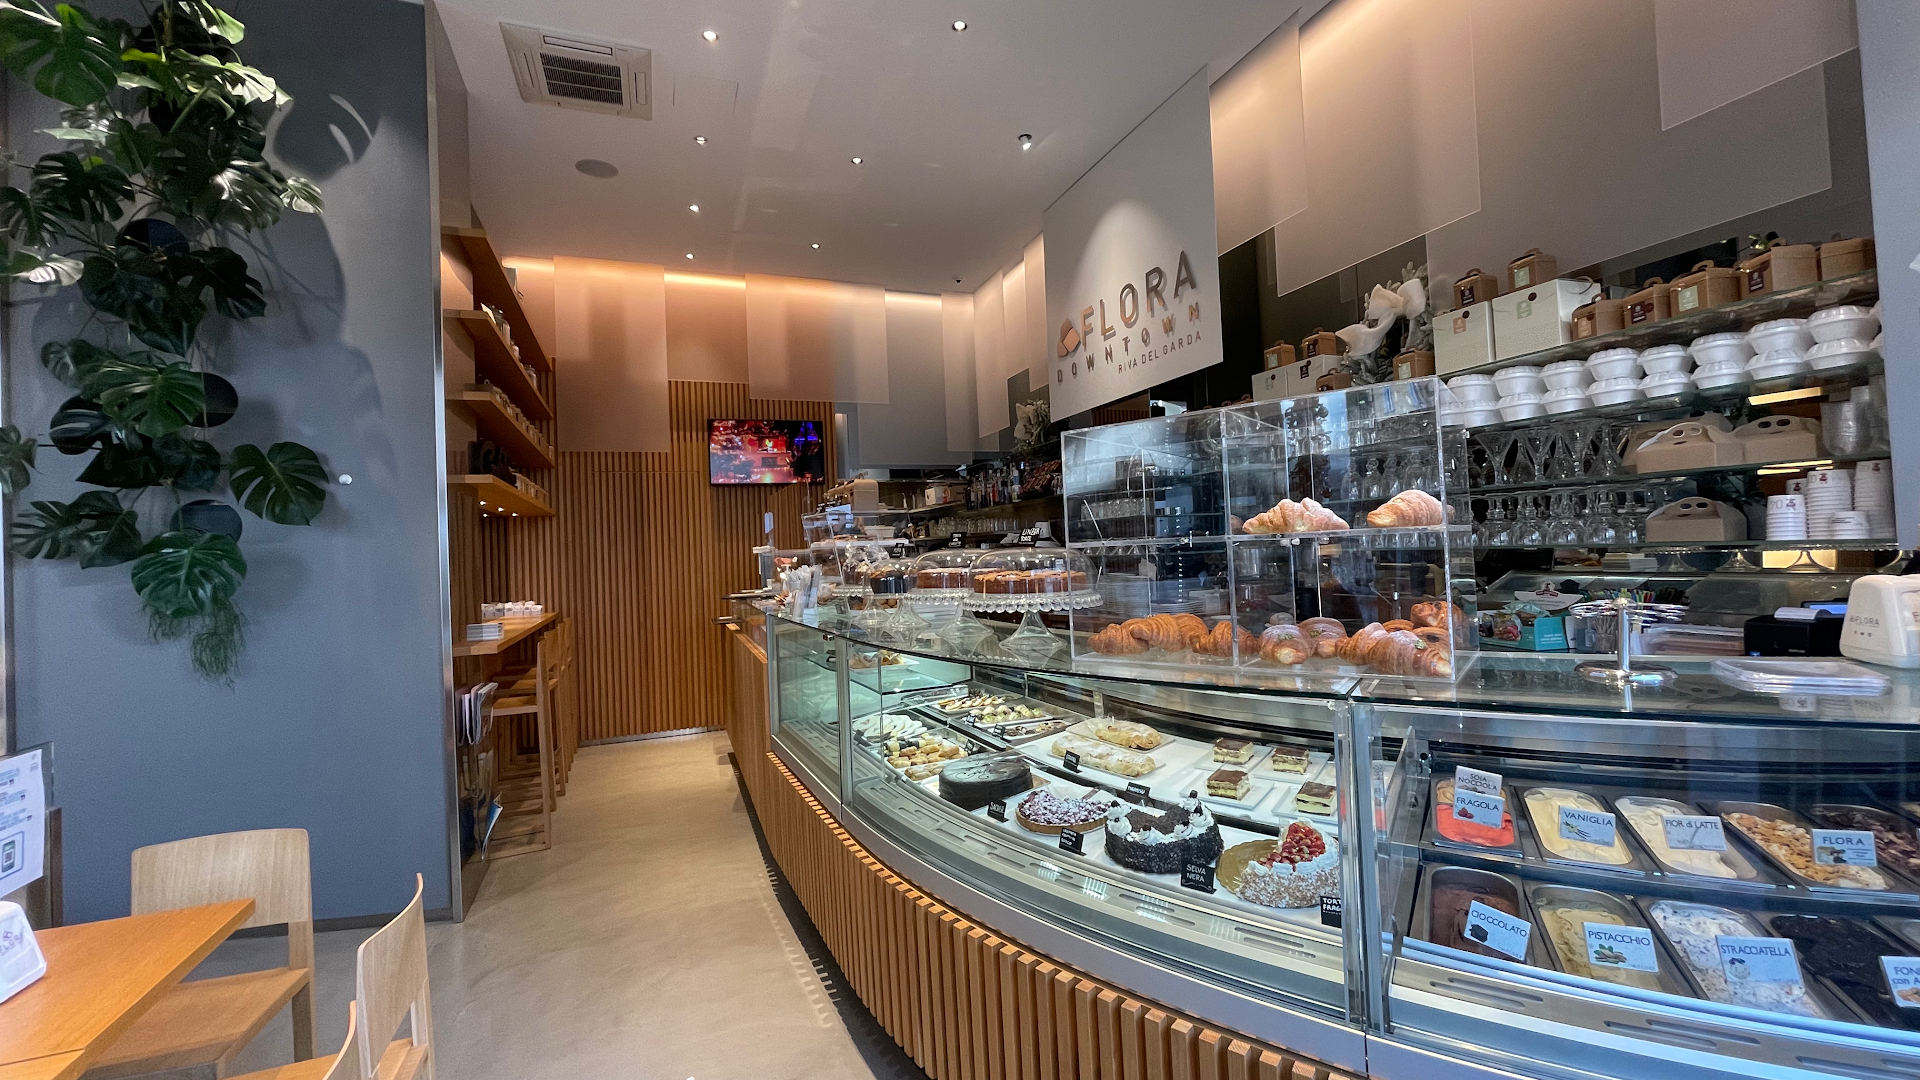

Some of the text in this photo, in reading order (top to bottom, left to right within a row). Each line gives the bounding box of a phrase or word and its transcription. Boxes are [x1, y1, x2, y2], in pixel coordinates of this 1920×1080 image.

[1081, 250, 1197, 347] FLORA
[1057, 302, 1200, 383] DOWNTOWN
[1118, 331, 1202, 374] RIVA DEL GARDA
[1458, 776, 1498, 792] NOCCIOLA
[1469, 773, 1488, 783] SOIA
[1456, 796, 1499, 811] FRAGOLA
[1563, 811, 1614, 827] VANIGLIA
[1665, 819, 1720, 830] FIOR di LATTE
[1822, 836, 1866, 847] FLORA
[1186, 863, 1206, 875] SELVA
[1186, 872, 1205, 882] NERA
[1471, 909, 1528, 938] CIOCCOLATO
[1588, 930, 1651, 946] PISTACCHIO
[1720, 944, 1792, 957] STRACCIATELLA
